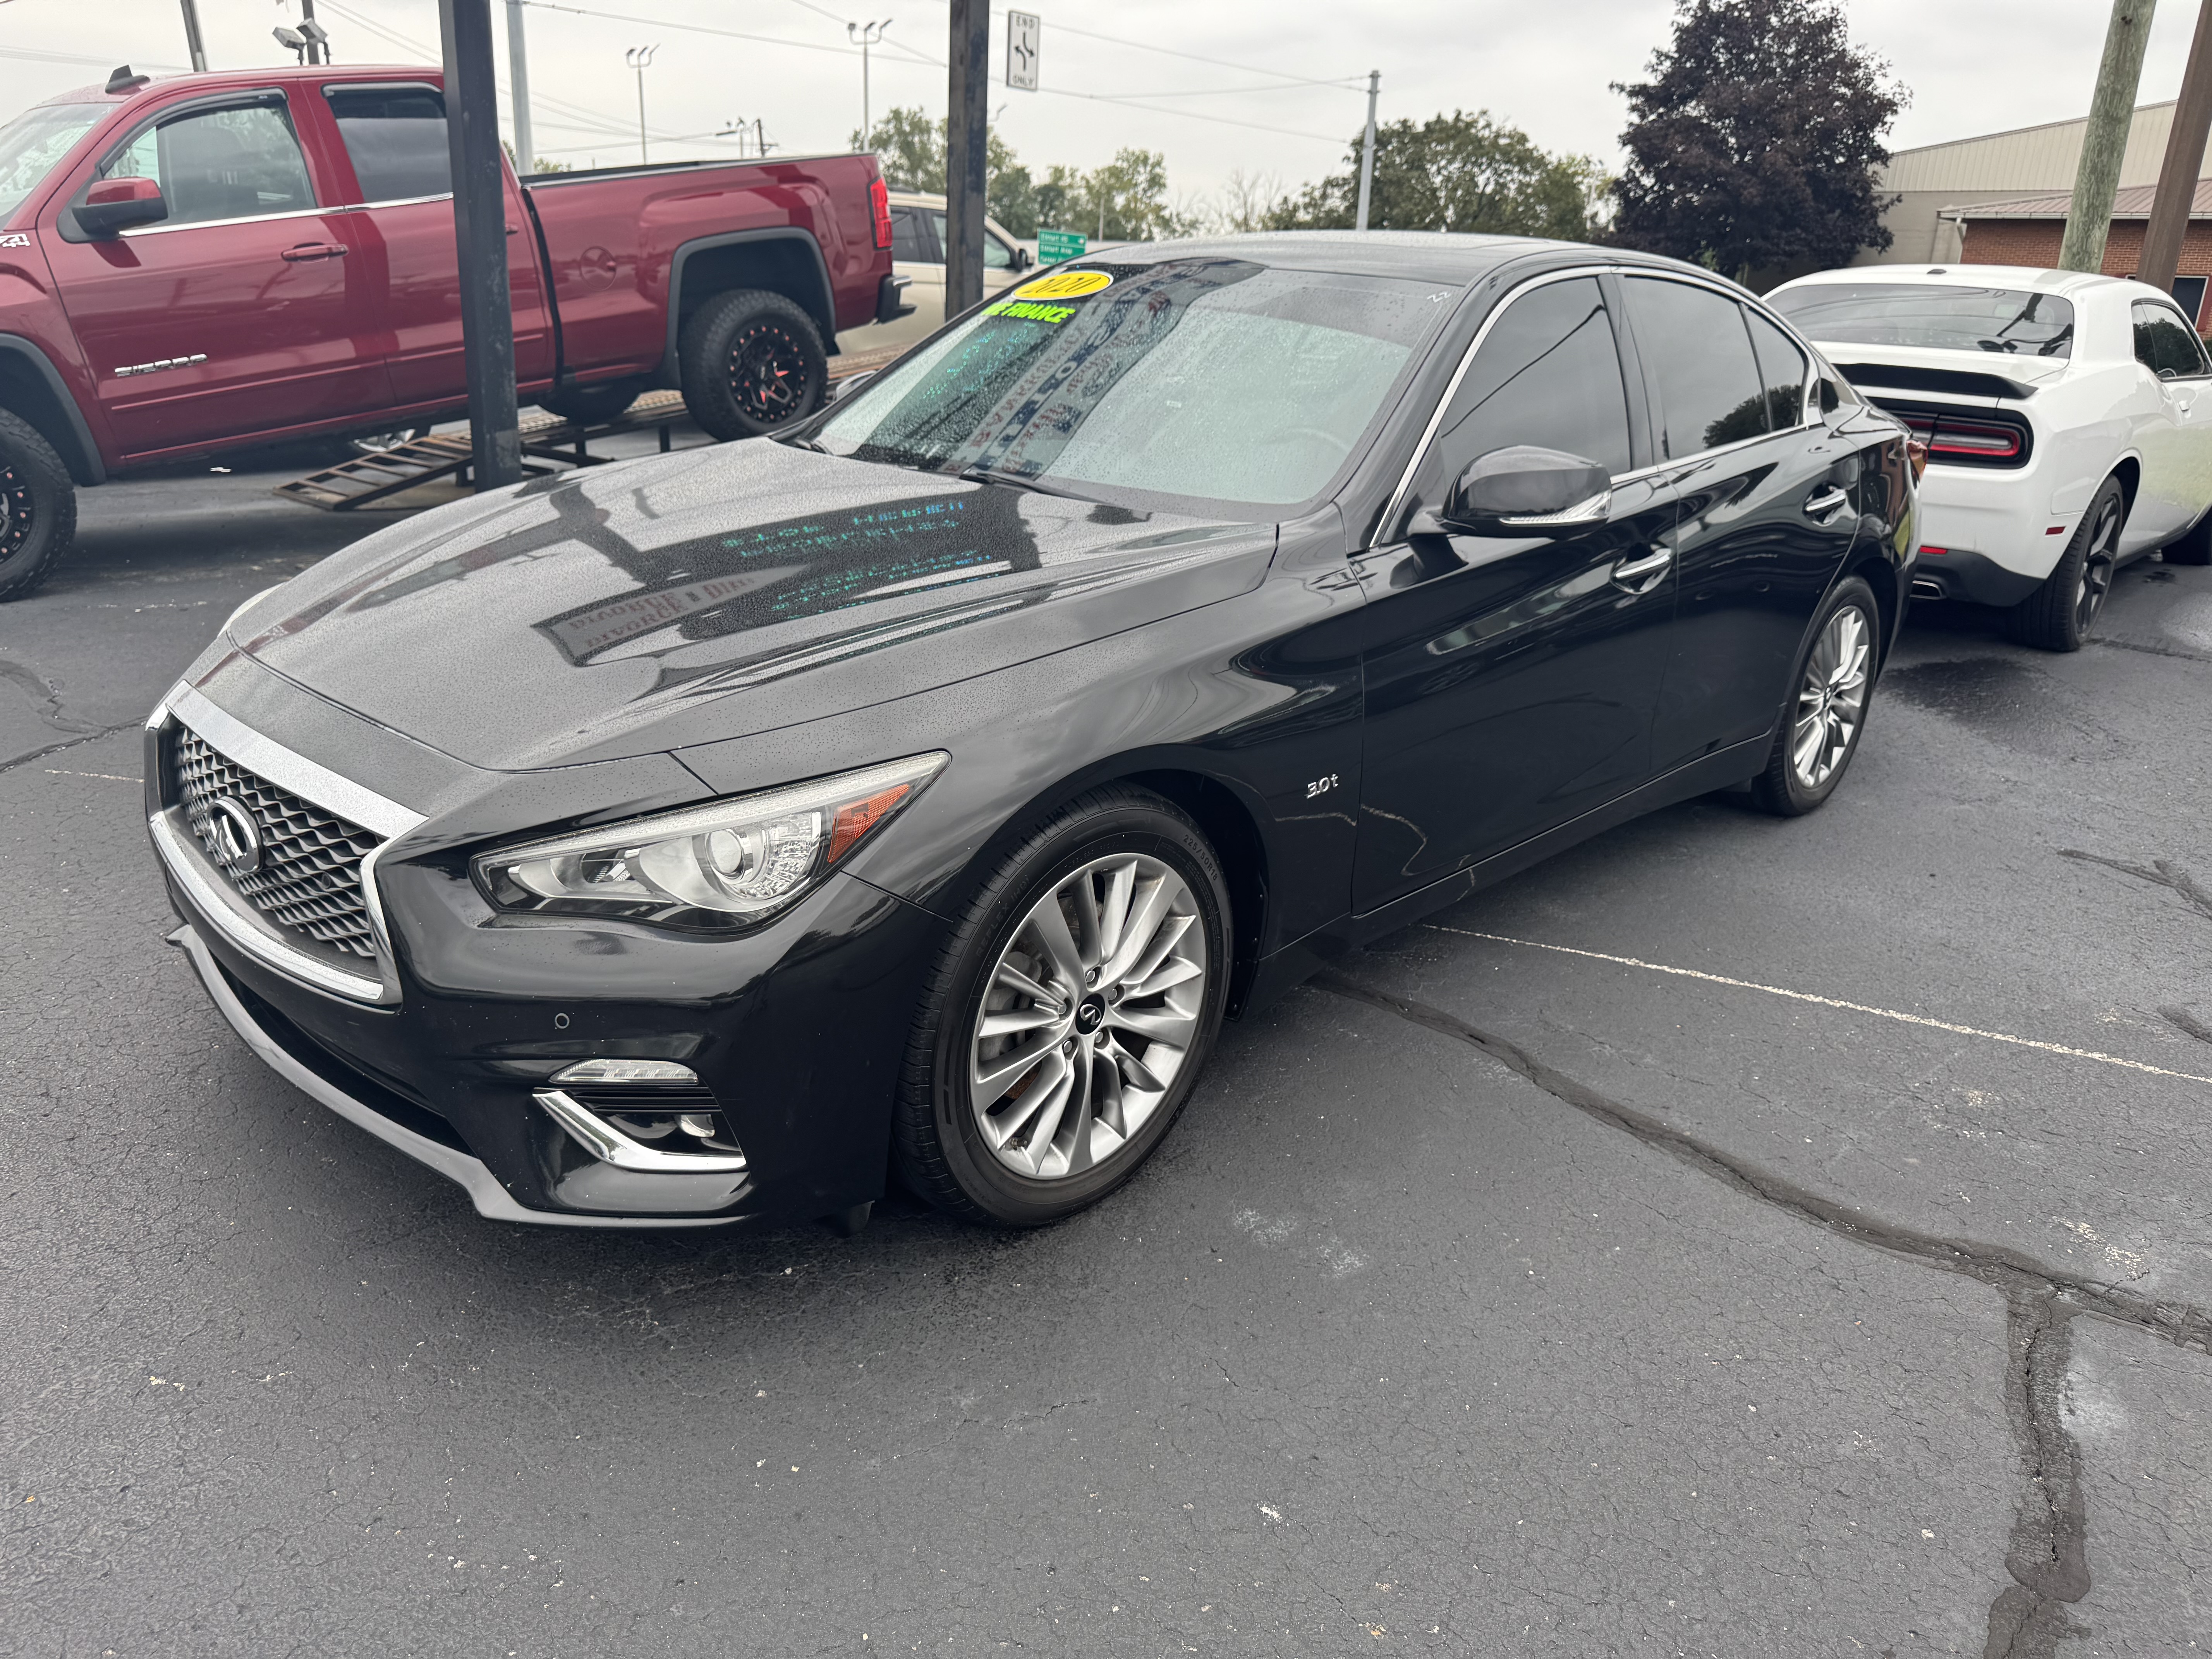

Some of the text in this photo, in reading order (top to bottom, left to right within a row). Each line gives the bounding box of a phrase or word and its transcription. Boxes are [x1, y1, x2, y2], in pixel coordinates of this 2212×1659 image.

[1016, 15, 1035, 29] END
[1012, 75, 1034, 87] ONLY
[1021, 276, 1102, 294] 2020
[981, 302, 1076, 323] WE FINANCE
[1183, 834, 1218, 881] 225/50R18
[975, 902, 1010, 958] REFLEX
